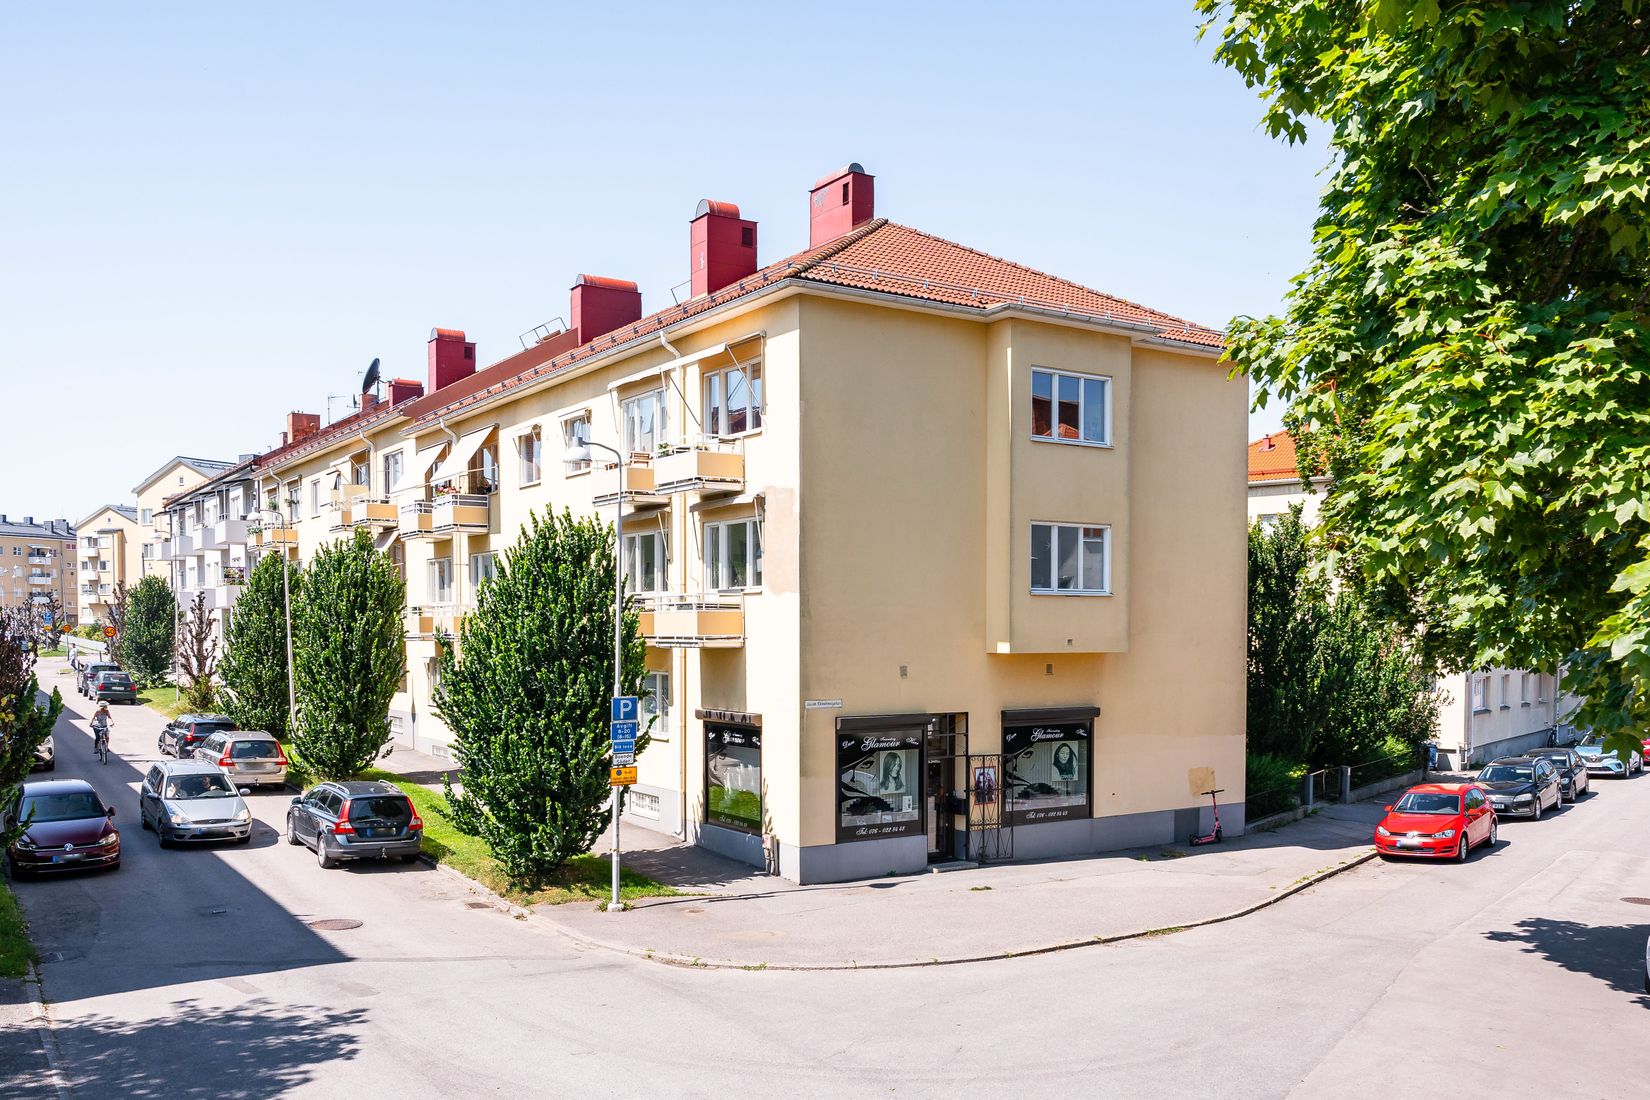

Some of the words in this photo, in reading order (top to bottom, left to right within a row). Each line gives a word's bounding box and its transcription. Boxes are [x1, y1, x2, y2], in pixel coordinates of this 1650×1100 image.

[620, 700, 632, 719] P
[1030, 728, 1064, 742] Glamour
[860, 736, 900, 752] Glamour
